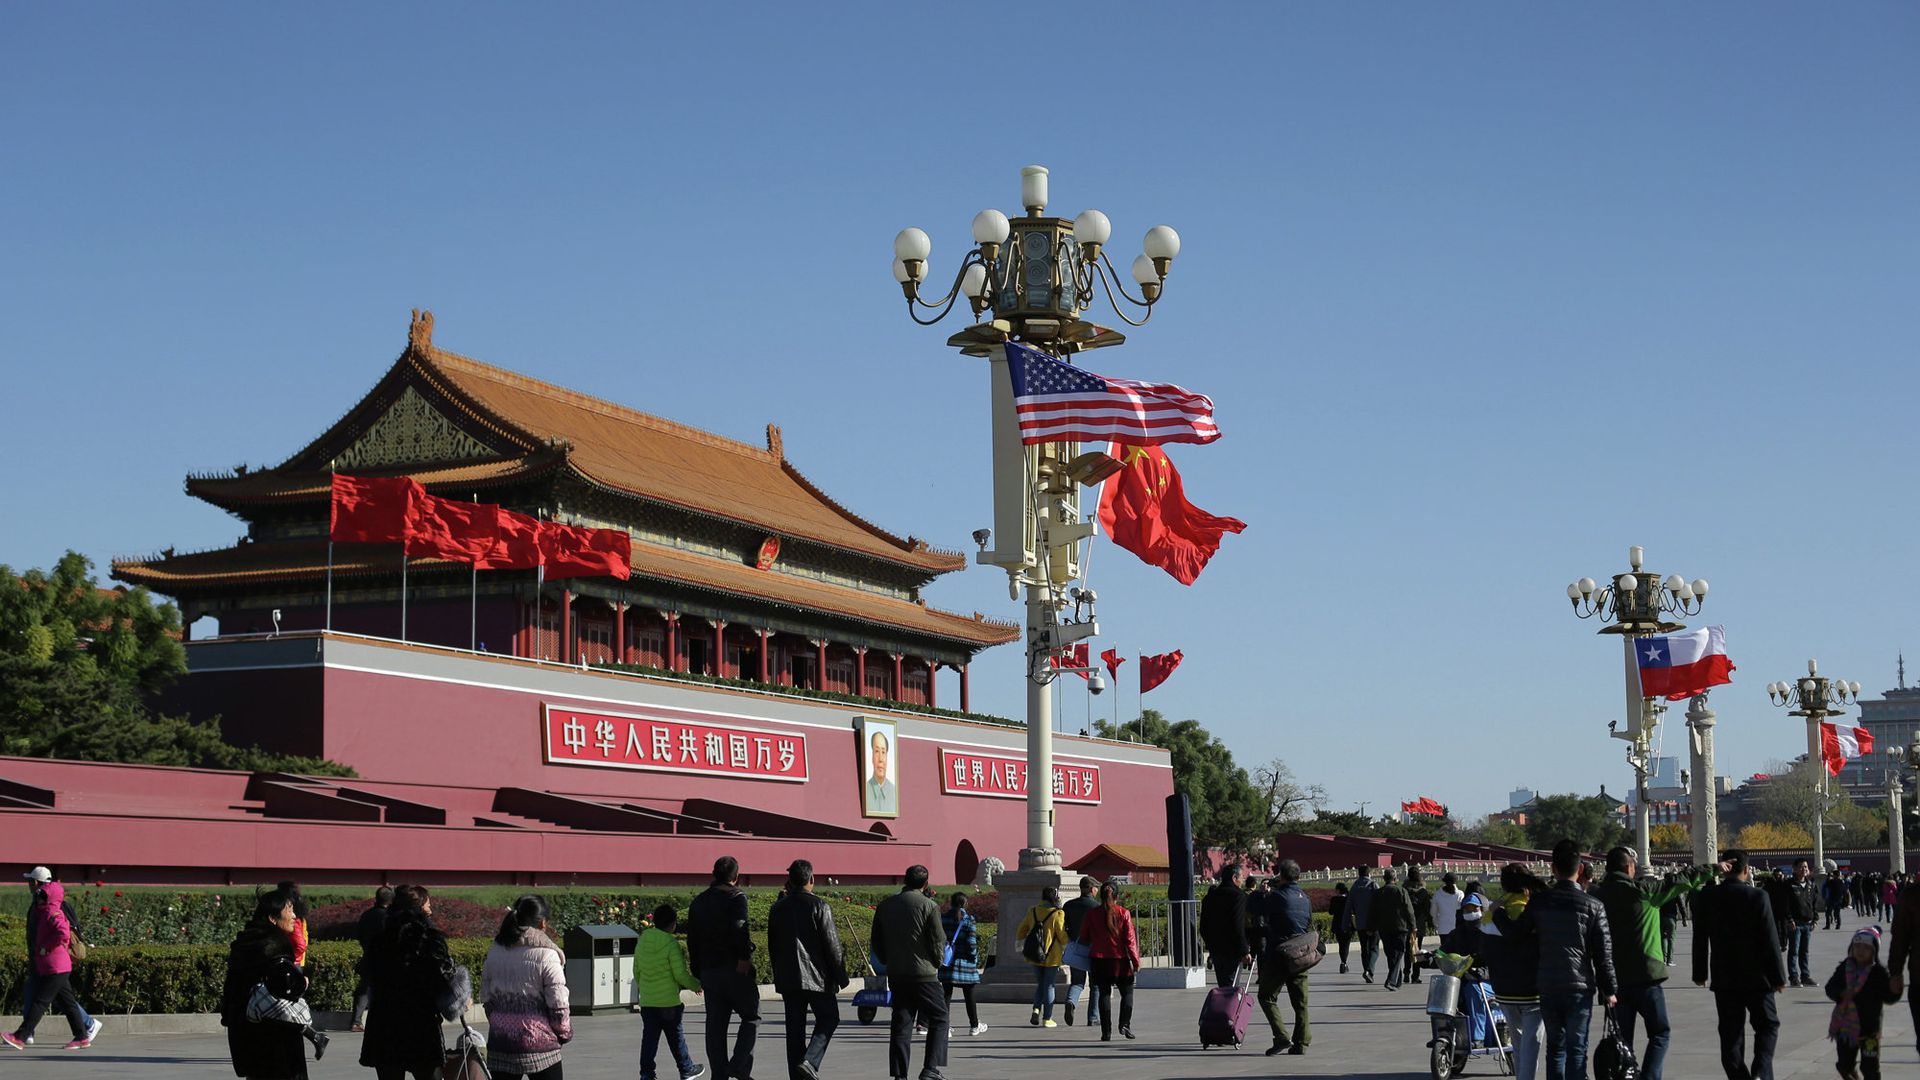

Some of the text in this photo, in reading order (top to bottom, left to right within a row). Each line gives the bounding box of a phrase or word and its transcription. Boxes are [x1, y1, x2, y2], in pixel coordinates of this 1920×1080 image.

[562, 716, 796, 773] 中华人民共和国万岁
[953, 757, 1094, 797] 世界人民结万岁
